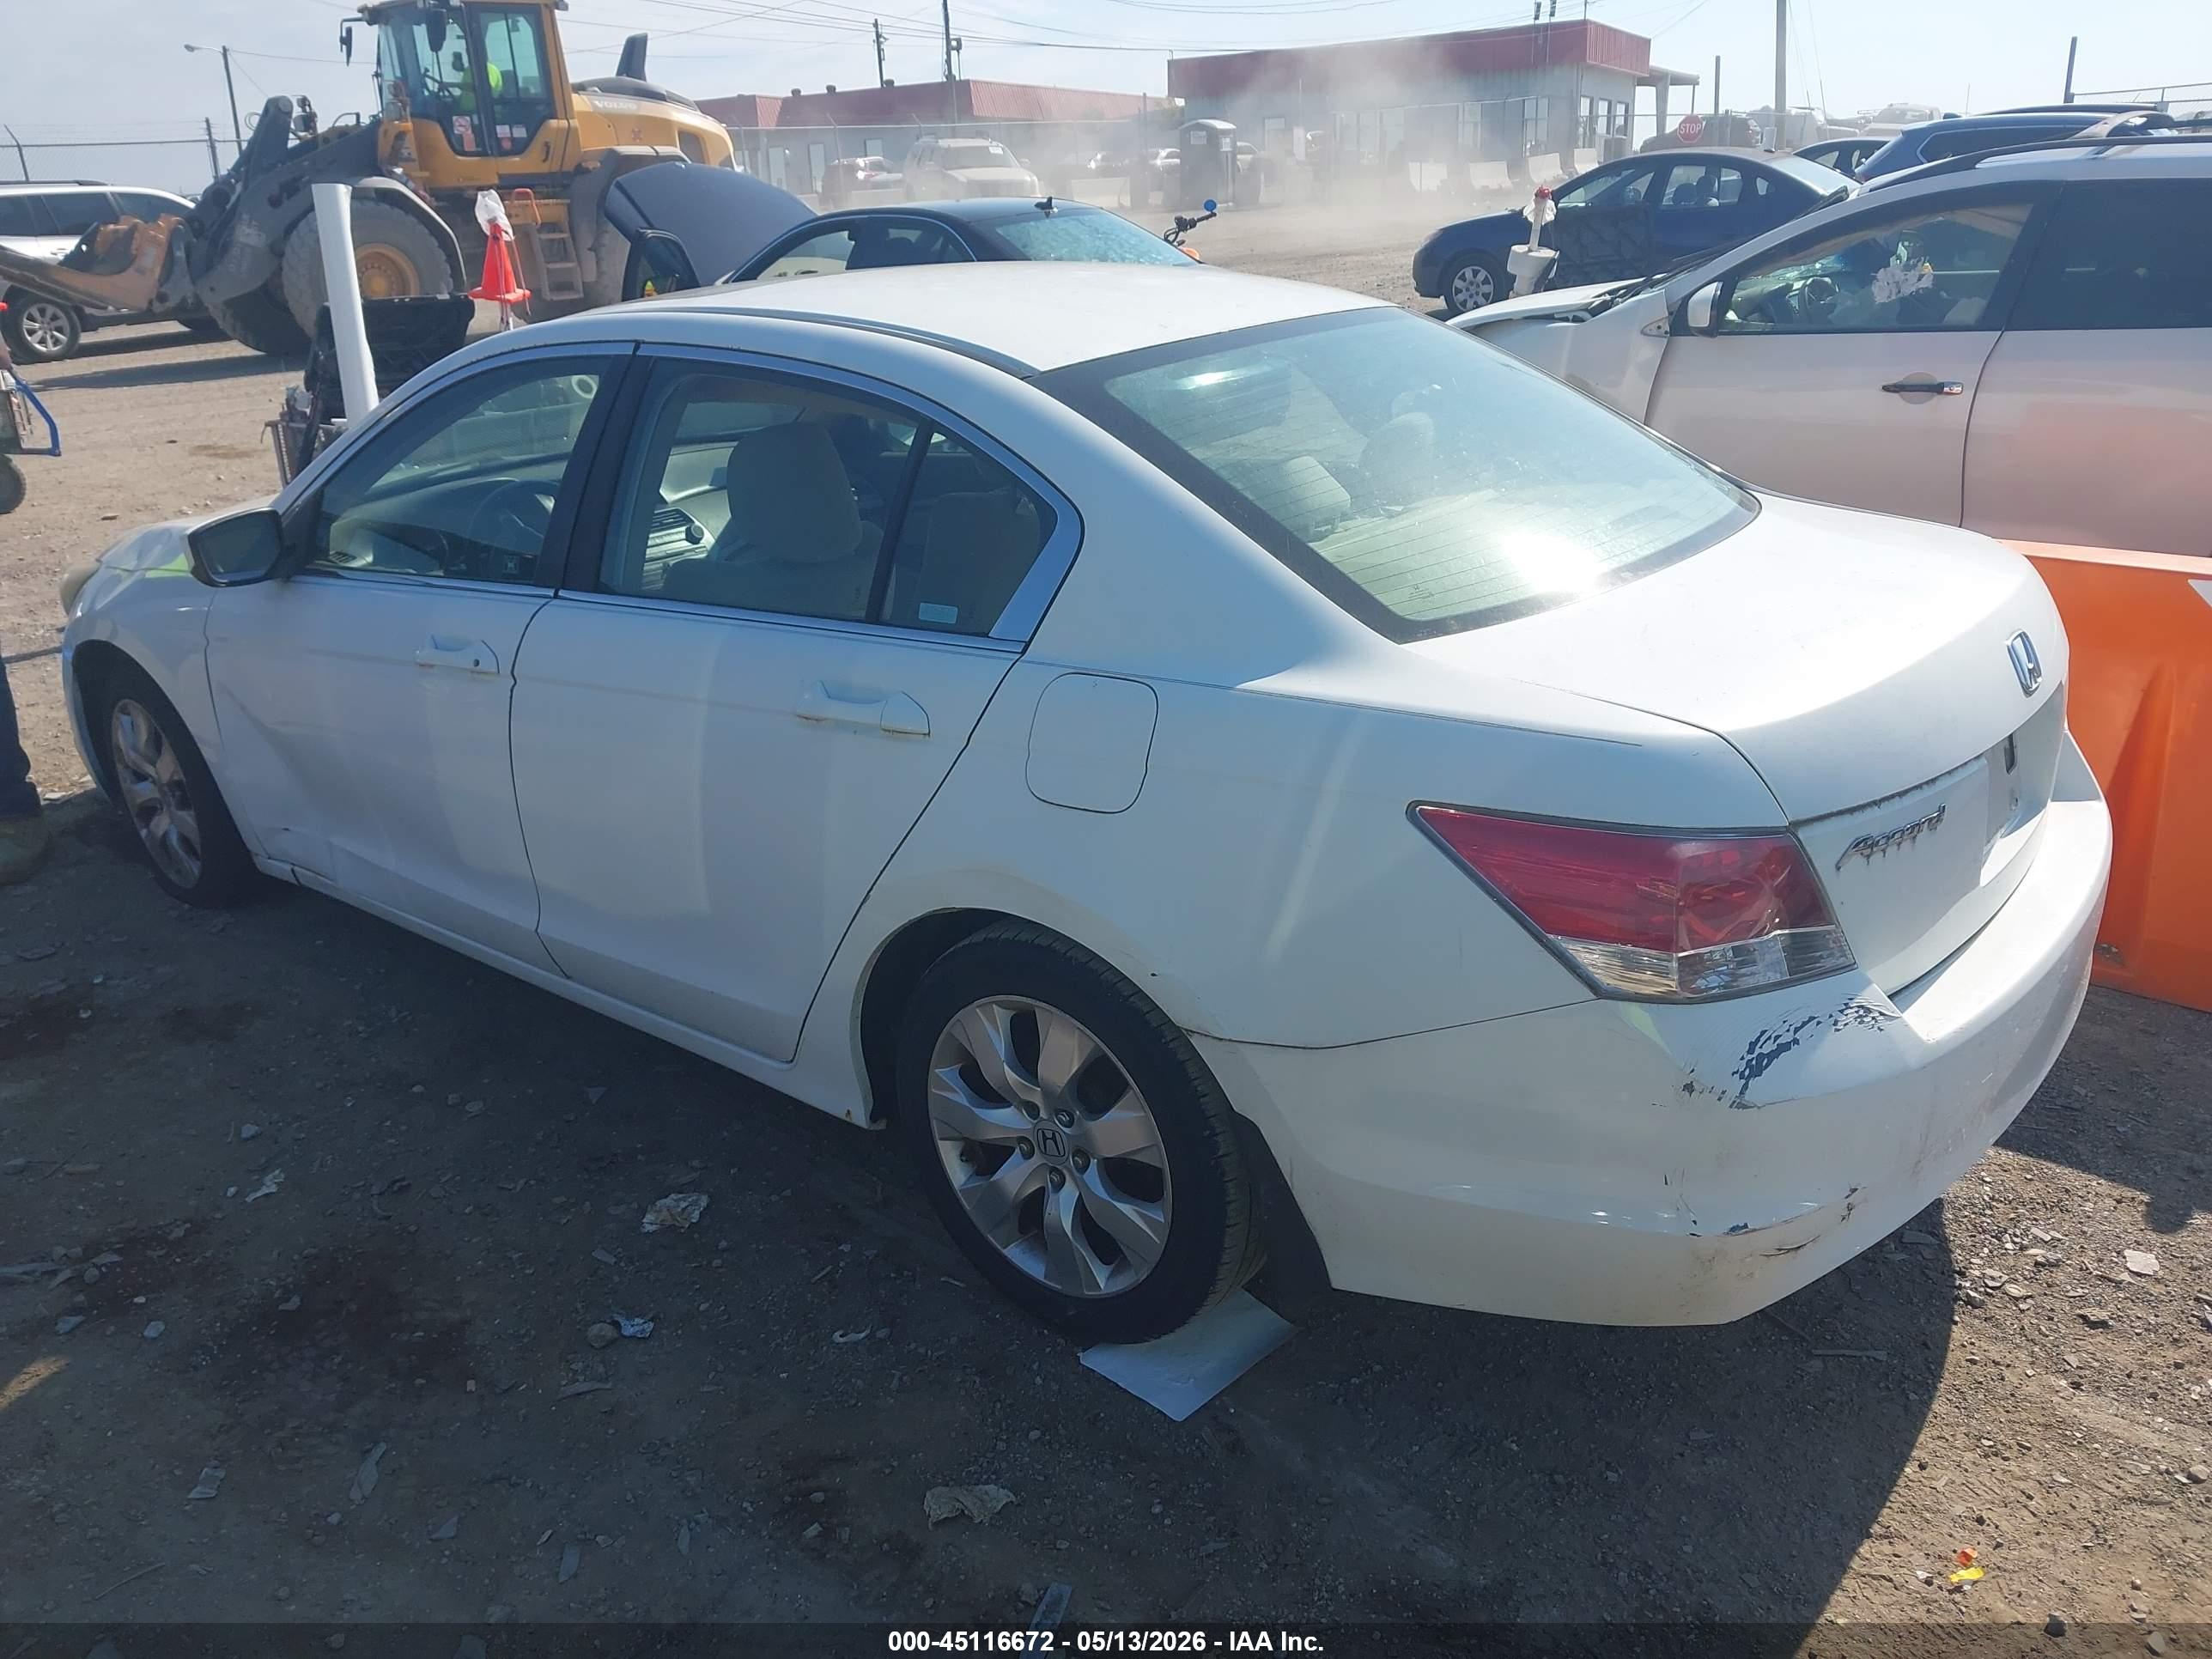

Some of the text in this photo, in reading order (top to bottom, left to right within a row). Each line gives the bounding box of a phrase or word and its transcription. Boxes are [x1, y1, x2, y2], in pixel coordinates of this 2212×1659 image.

[594, 100, 638, 110] VOLVO
[1680, 123, 1702, 134] STOP
[1834, 802, 1947, 872] Accord
